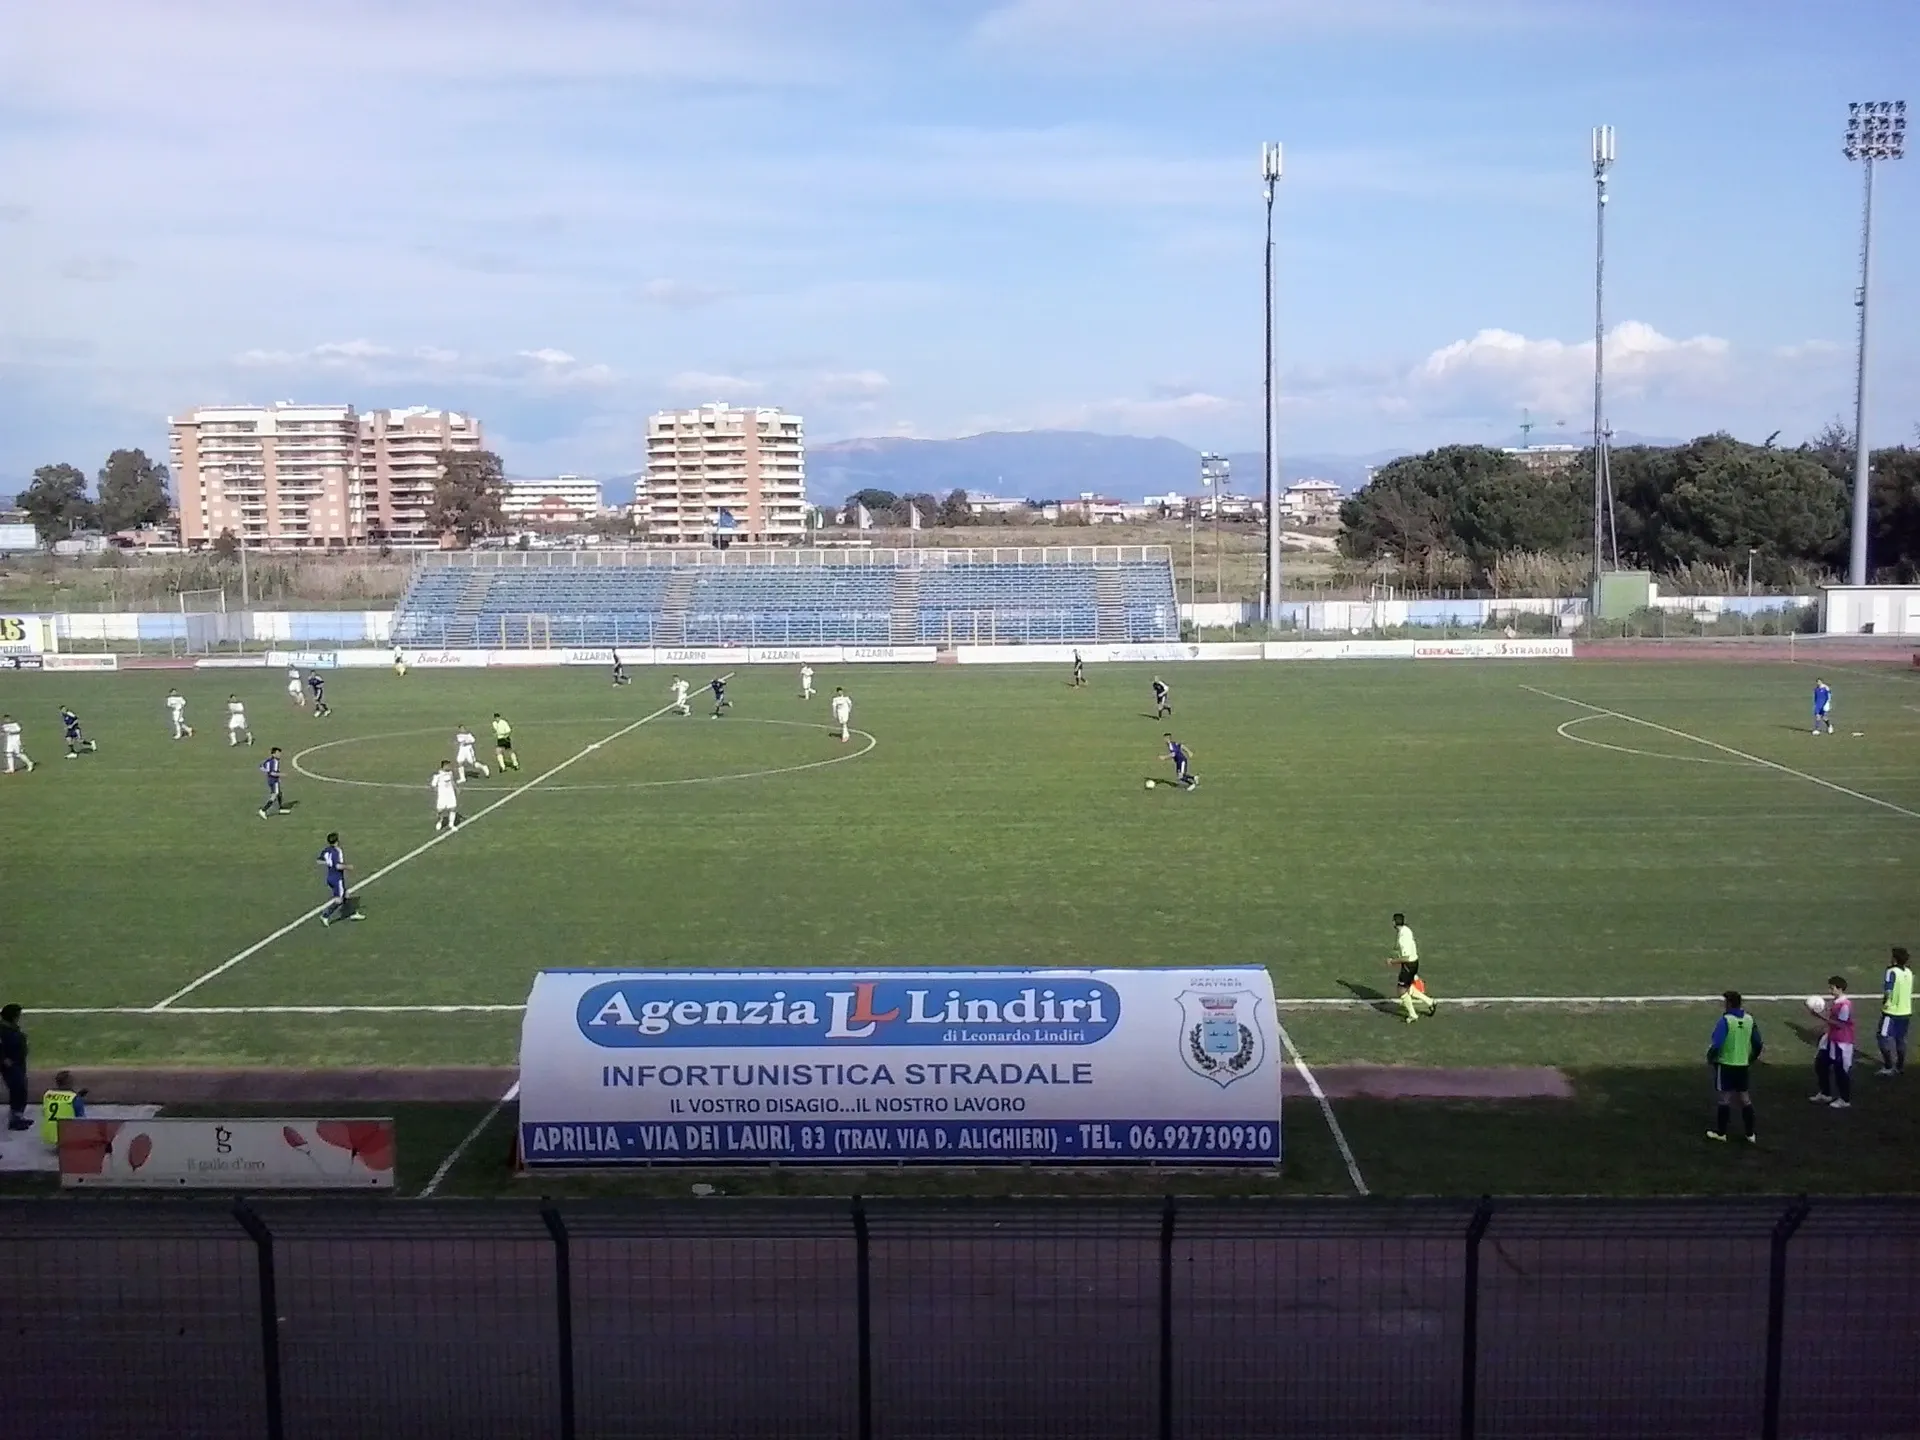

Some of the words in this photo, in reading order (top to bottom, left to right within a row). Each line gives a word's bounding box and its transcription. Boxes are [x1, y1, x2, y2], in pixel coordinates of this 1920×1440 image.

[666, 651, 706, 660] AZZARINI
[761, 651, 800, 660] AZZARINI
[855, 649, 894, 657] AZZARINI
[589, 991, 820, 1035] Agenzia
[905, 988, 1108, 1024] Lindiri
[943, 1029, 957, 1042] di
[961, 1029, 1031, 1042] Leonardo
[1036, 1028, 1085, 1042] Lindiri
[603, 1064, 895, 1087] INFORTUNISTICA
[905, 1063, 1094, 1085] STRADALE
[670, 1100, 686, 1113] IL
[690, 1099, 761, 1113] VOSTRO
[875, 1098, 949, 1112] NOSTRO
[954, 1098, 1026, 1112] LAVORO
[215, 1125, 232, 1153] g
[532, 1126, 618, 1151] APRILIA
[639, 1127, 681, 1150] VIA
[686, 1126, 720, 1150] DEI
[727, 1125, 795, 1151] LAURI,
[801, 1127, 825, 1149] 83
[833, 1128, 893, 1153] (TRAV.
[896, 1128, 930, 1150] VIA
[934, 1128, 953, 1150] D.
[958, 1127, 1058, 1152] ALIGHIERI)
[1079, 1124, 1122, 1149] TEL.
[1129, 1125, 1272, 1150] 06.92730930
